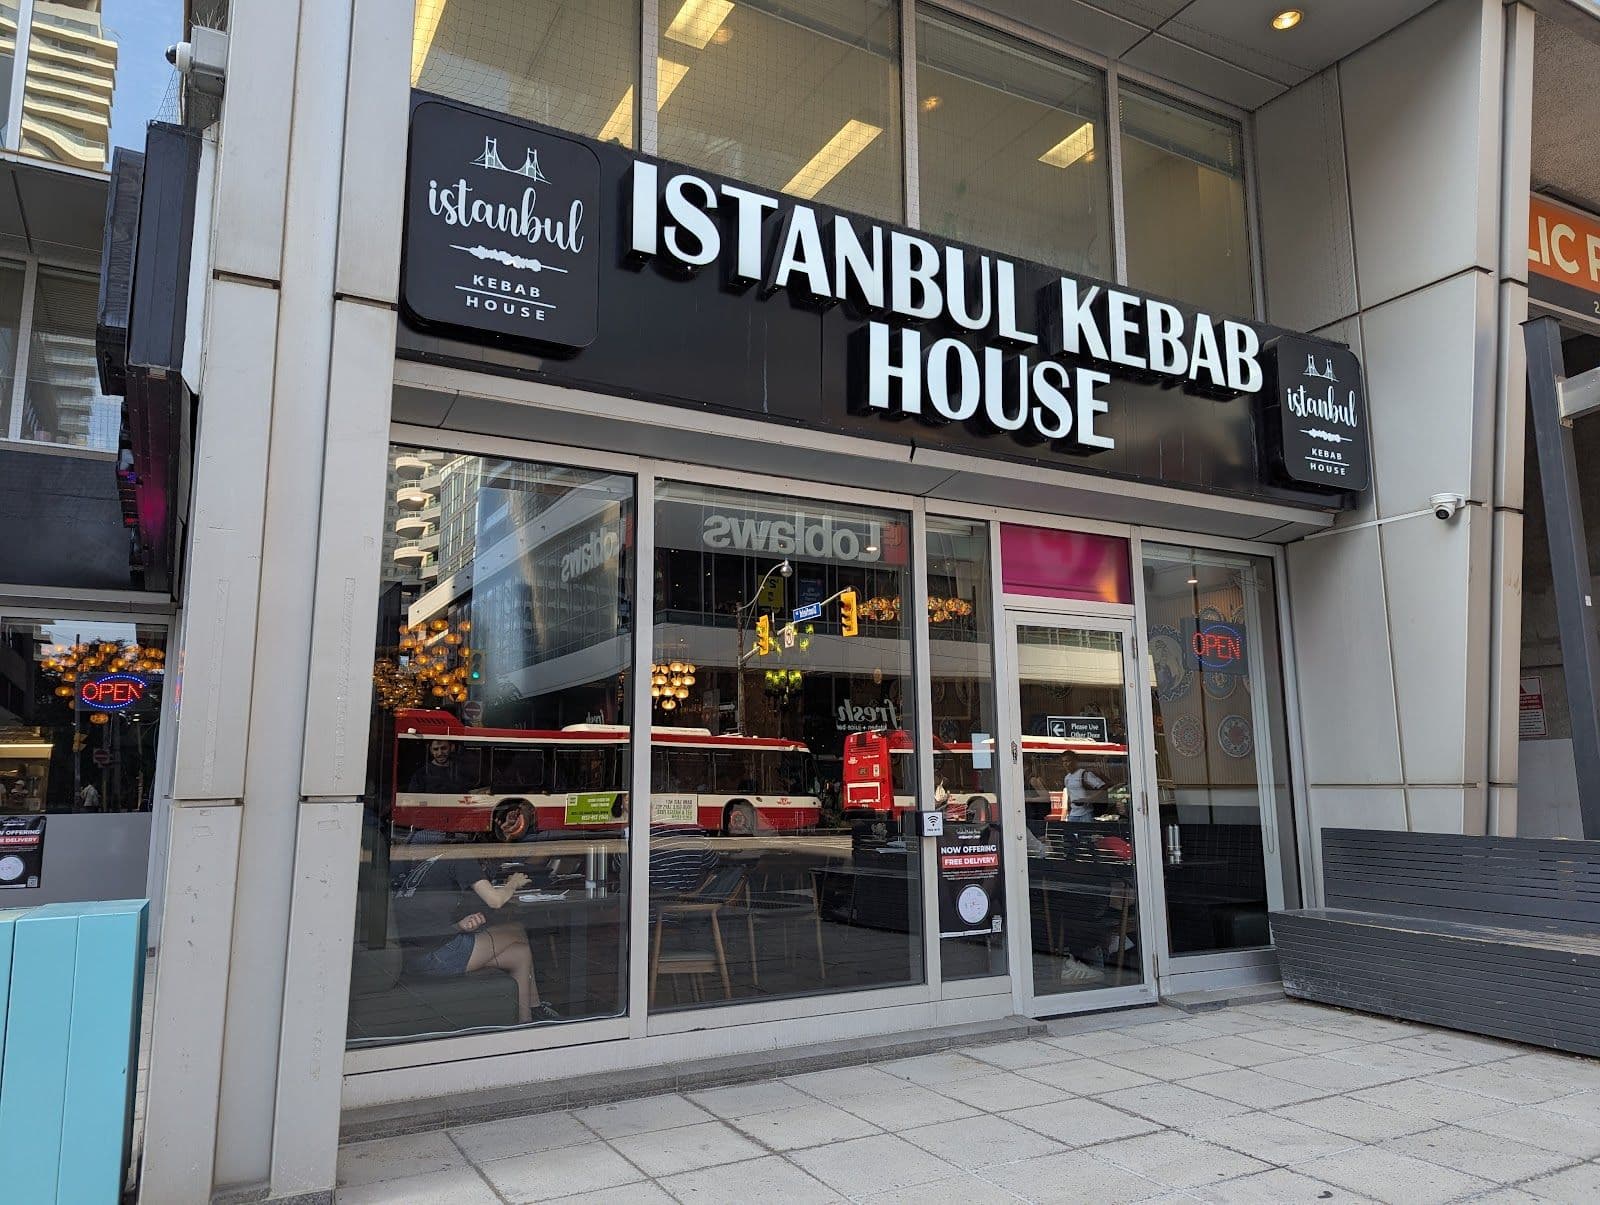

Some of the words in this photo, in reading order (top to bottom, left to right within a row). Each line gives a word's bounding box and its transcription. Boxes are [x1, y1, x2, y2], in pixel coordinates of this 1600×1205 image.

[427, 178, 585, 254] istanbul
[473, 274, 541, 298] KEBAB
[632, 160, 1038, 344] ISTANBUL
[1060, 277, 1264, 393] KEBAB
[466, 295, 545, 321] HOUSE
[869, 321, 1115, 449] HOUSE
[1287, 384, 1358, 428] istanbul
[1311, 447, 1342, 461] KEBAB
[1310, 462, 1346, 476] HOUSE
[1192, 632, 1241, 660] OPEN
[82, 681, 144, 701] OPEN
[1088, 723, 1099, 731] Use
[940, 845, 961, 854] NOW
[963, 844, 997, 854] OFFERING
[944, 857, 963, 866] FREE
[963, 856, 996, 865] DELIVERY
